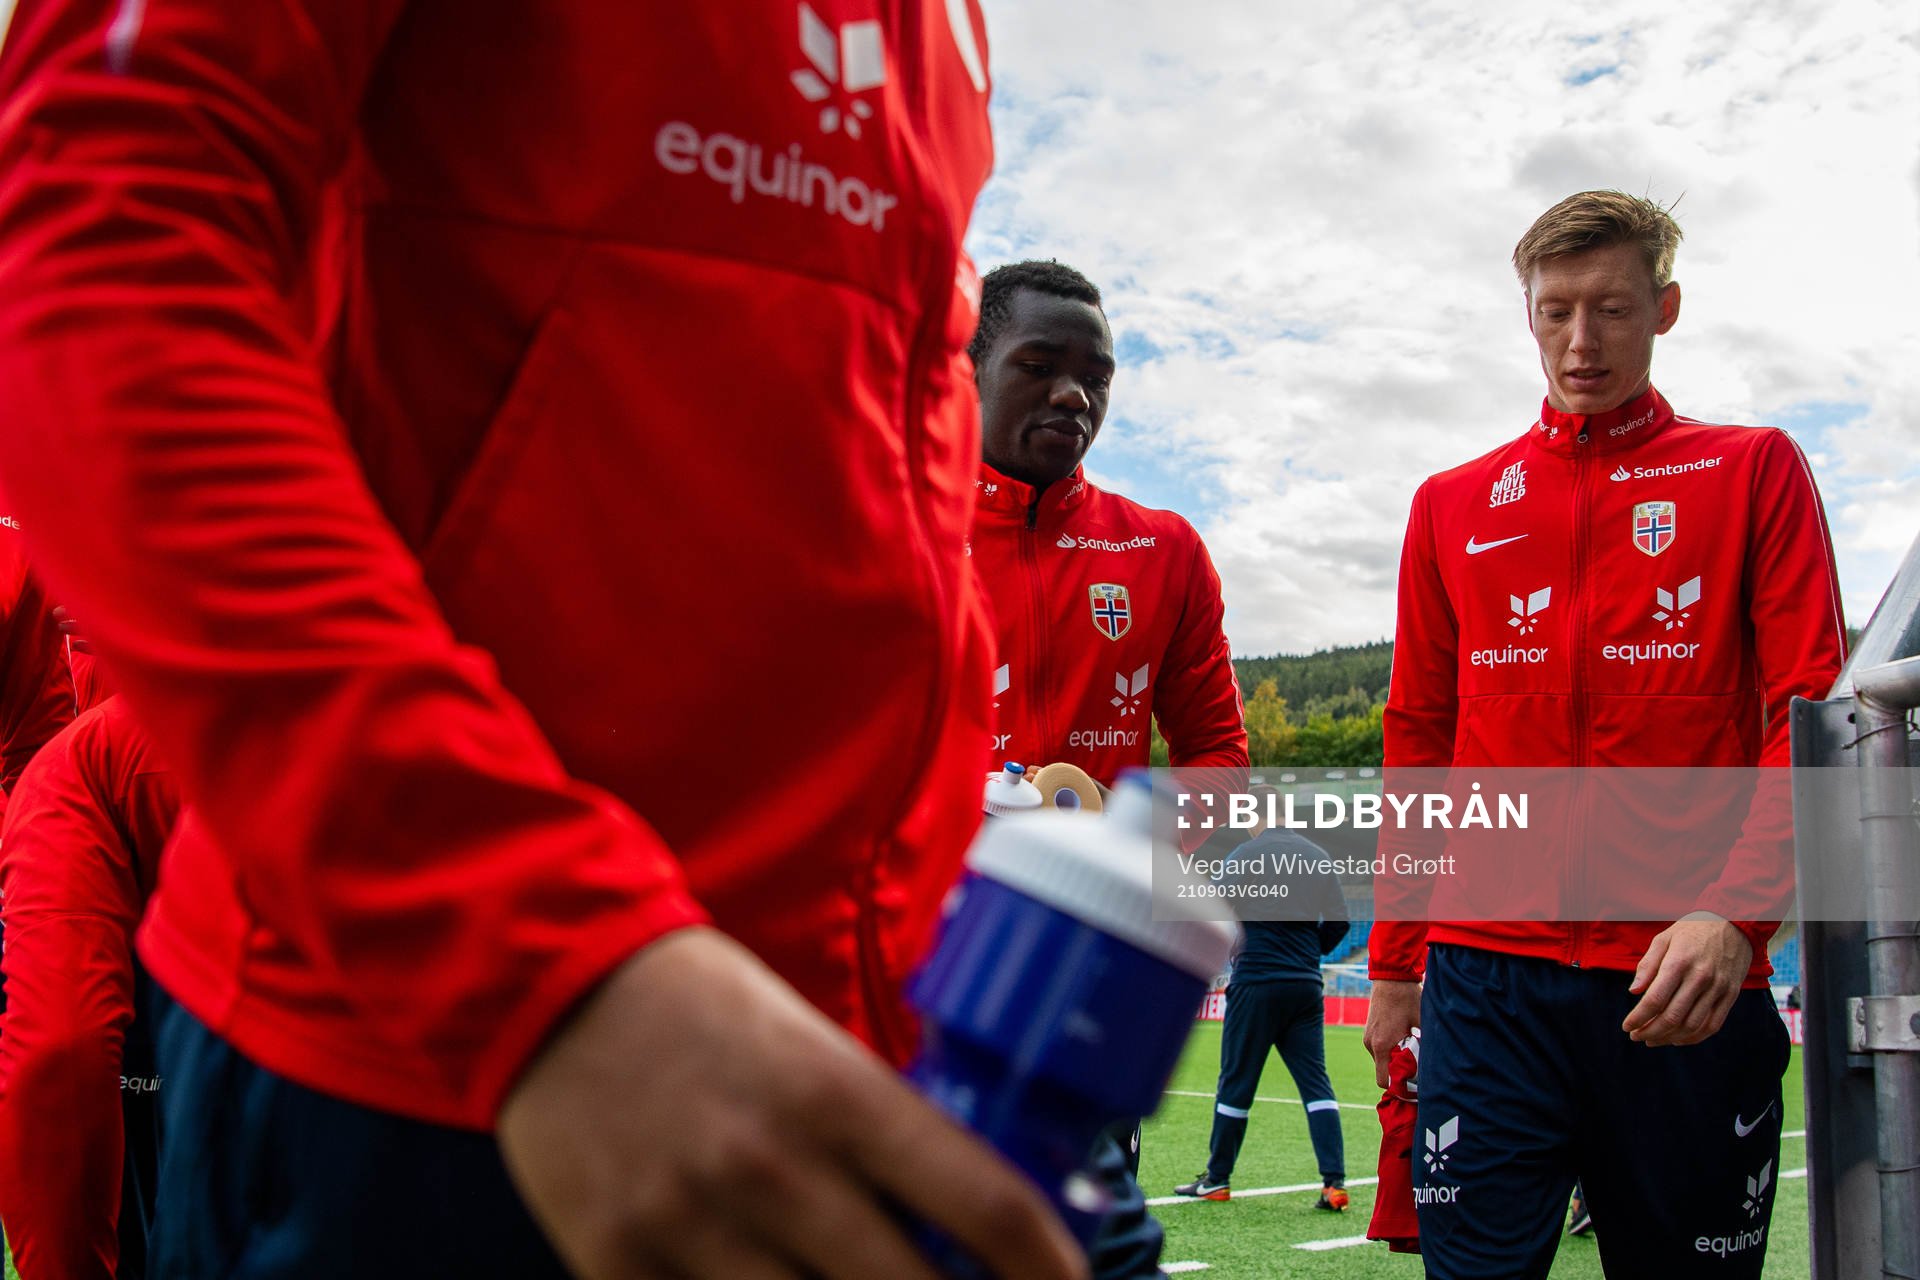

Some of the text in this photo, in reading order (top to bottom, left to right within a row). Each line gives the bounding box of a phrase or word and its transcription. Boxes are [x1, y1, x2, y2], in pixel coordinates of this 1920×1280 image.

[654, 120, 898, 232] equinor
[1608, 415, 1646, 437] equinor
[1502, 460, 1525, 480] EAT
[1633, 456, 1723, 479] Santander
[1491, 470, 1527, 496] MOVE
[1489, 487, 1526, 508] SLEEP
[1077, 536, 1157, 553] Santander
[1470, 644, 1549, 669] equinor
[1601, 640, 1701, 665] equinor
[1069, 726, 1139, 752] equinor
[1694, 1225, 1765, 1259] equinor
